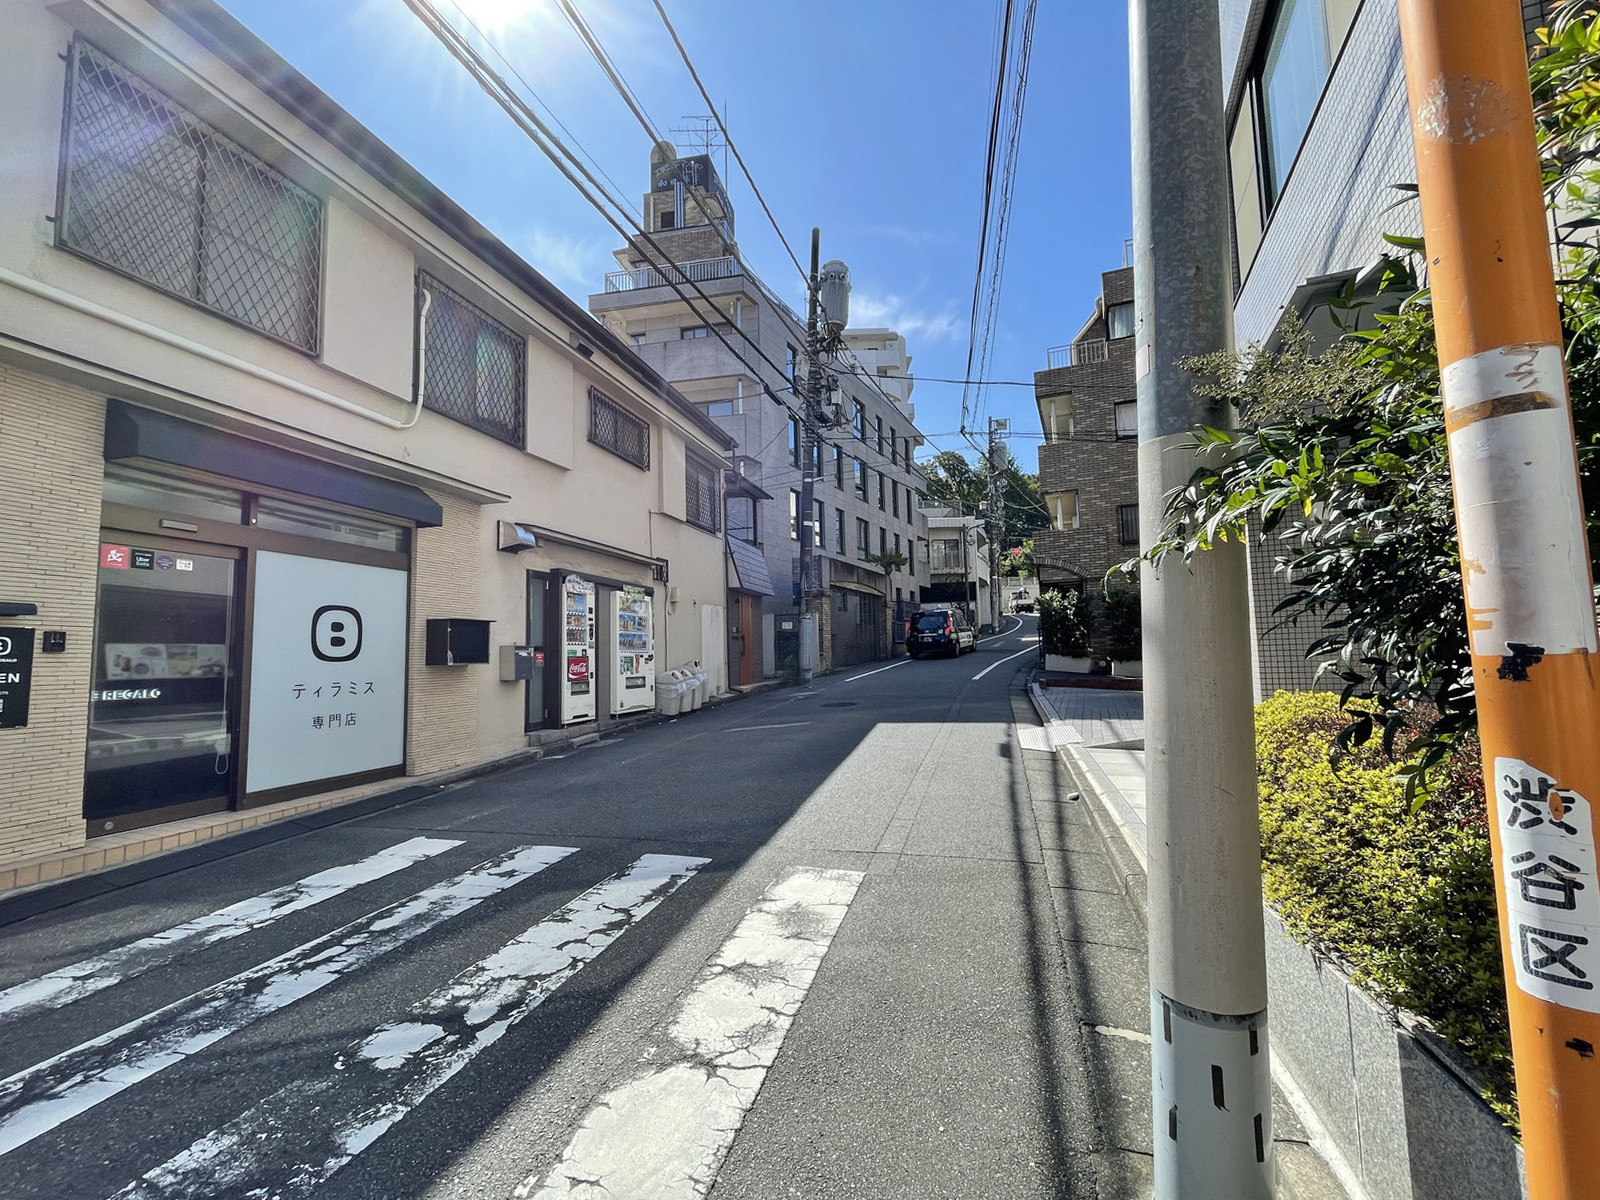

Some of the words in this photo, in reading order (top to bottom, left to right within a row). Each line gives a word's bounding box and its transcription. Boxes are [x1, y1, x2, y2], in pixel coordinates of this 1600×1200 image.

[102, 689, 161, 701] REGALO
[292, 681, 375, 700] ティラミス
[312, 712, 358, 729] 専門店
